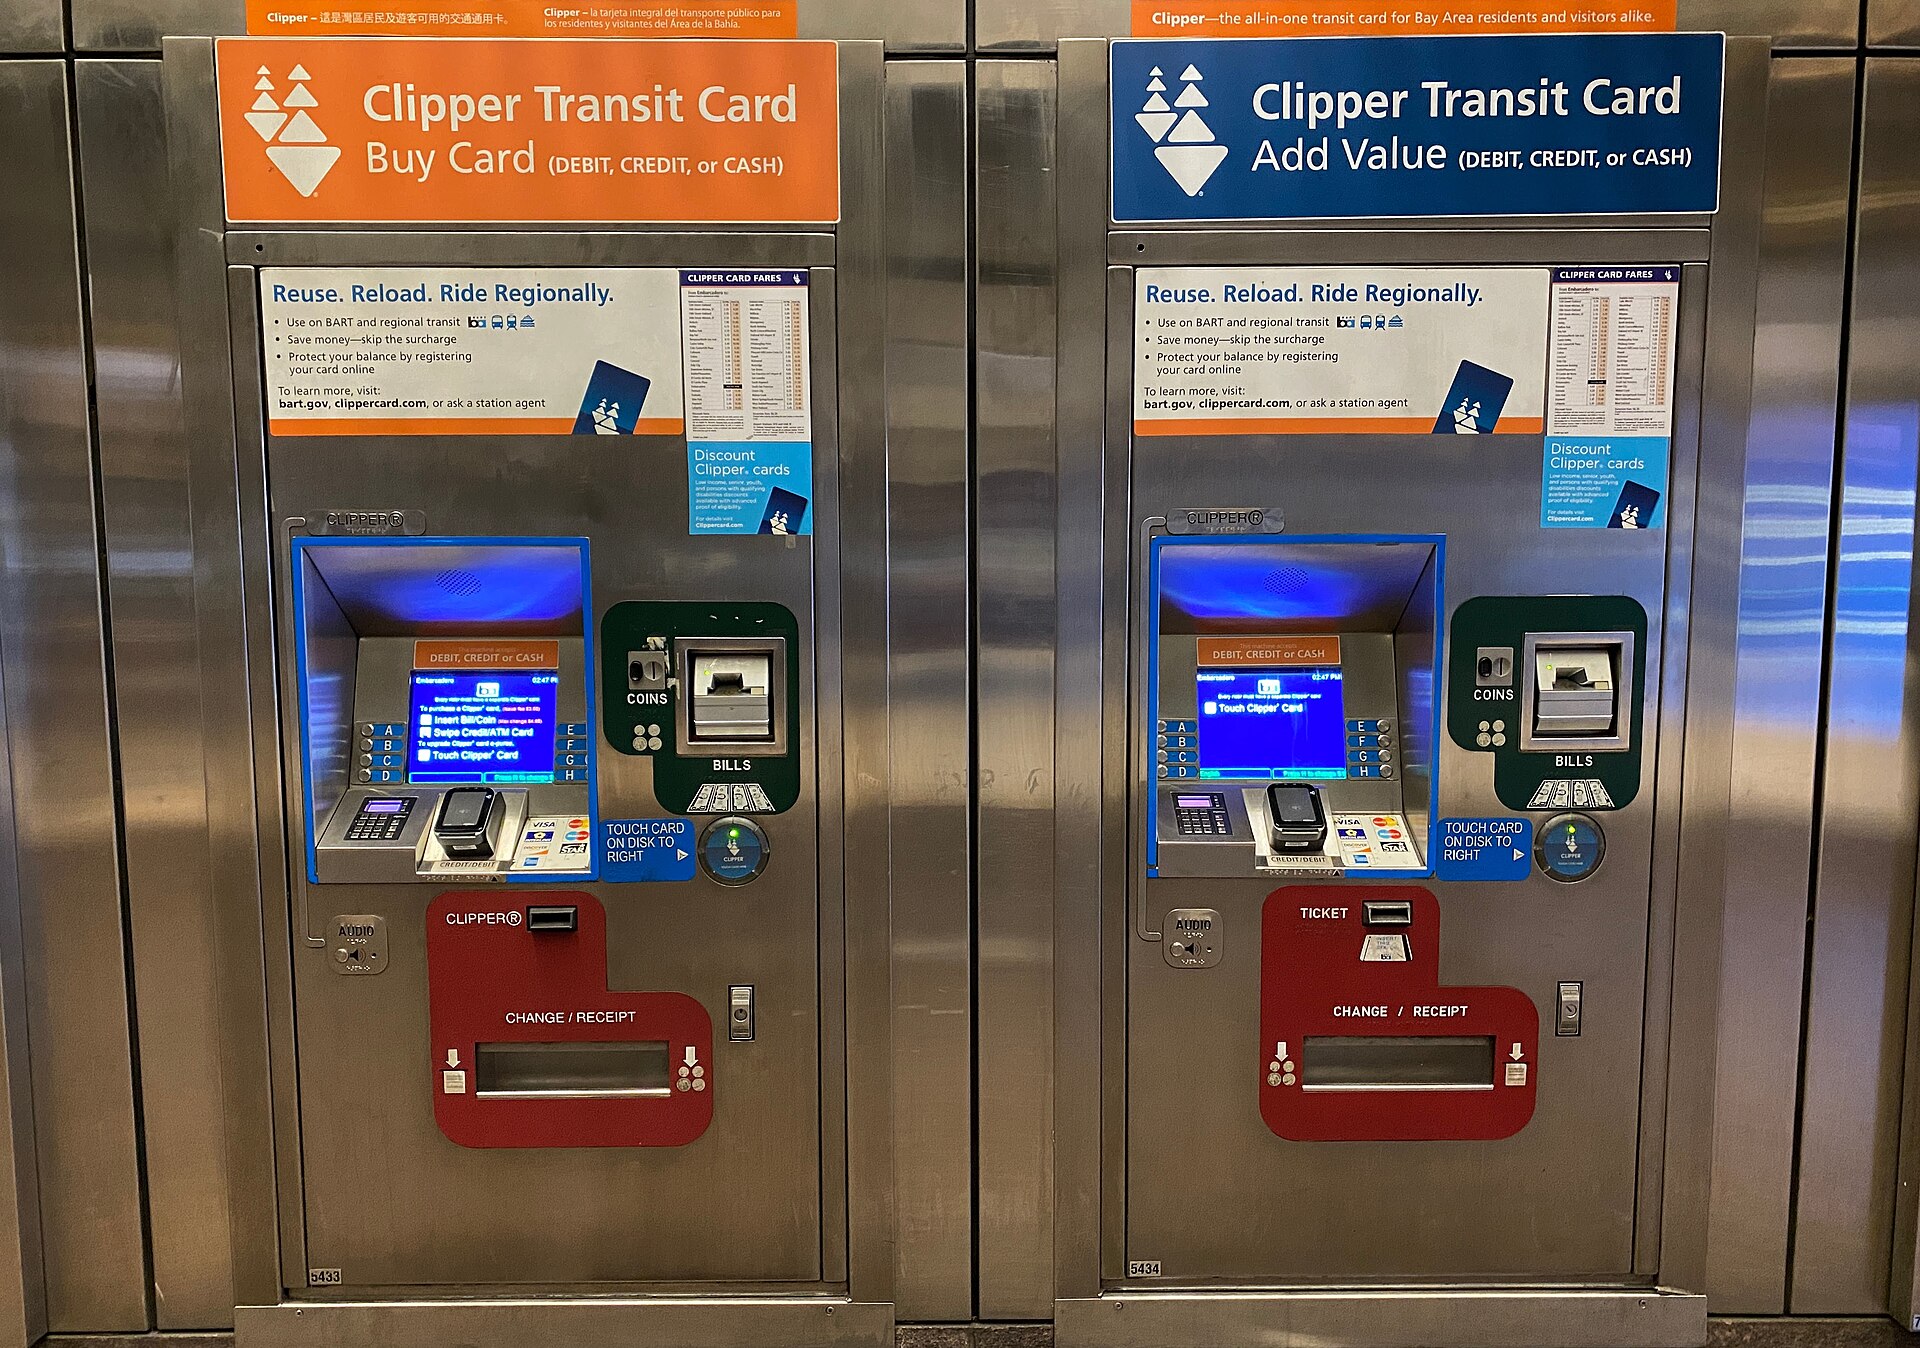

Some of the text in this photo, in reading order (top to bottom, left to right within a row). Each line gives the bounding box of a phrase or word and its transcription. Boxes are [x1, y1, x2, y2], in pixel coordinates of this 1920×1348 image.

[267, 12, 312, 24] Clipper
[544, 8, 781, 19] Clipper la tarjeta integral del transporte público para
[1152, 9, 1654, 27] Clipper—the all-in-one transit card for Bay Area residents and visitors alike.
[544, 18, 740, 30] los residentes y visitantes del Área de la Bahía.
[363, 83, 796, 131] Clipper Transit Card
[1252, 76, 1680, 128] Clipper Transit Card
[1251, 136, 1446, 170] Add Value
[1458, 147, 1691, 170] (DEBIT, CREDIT, or CASH)
[367, 140, 534, 182] Buy Card
[548, 156, 783, 175] (DEBIT, CREDIT, or CASH)
[687, 274, 781, 283] CLIPPER CARD FARES
[1559, 270, 1652, 279] CLIPPER CARD FARES
[273, 282, 613, 306] Reuse. Reload. Ride Regionally.
[1146, 283, 1482, 306] Reuse. Reload. Ride Regionally.
[1158, 318, 1176, 327] Use
[1196, 317, 1224, 327] BART
[1226, 317, 1246, 327] and
[1249, 316, 1292, 329] regional
[1296, 316, 1329, 326] transit
[287, 334, 456, 346] Save money—skip the surcharge
[288, 351, 471, 363] Protect your balance by registering
[289, 364, 374, 376] your card online
[277, 385, 380, 396] To learn more, visit:
[279, 399, 330, 410] bart.gov,
[334, 398, 428, 410] clippercard.com,
[446, 397, 463, 407] ask
[475, 398, 511, 407] station
[515, 399, 545, 409] agent
[1551, 442, 1611, 454] Discount
[694, 449, 755, 461] Discount
[1607, 457, 1644, 469] cards
[752, 464, 790, 475] cards
[430, 653, 460, 662] DEBIT,
[463, 653, 499, 662] CREDIT
[516, 653, 543, 662] CASH
[1212, 650, 1242, 659] DEBIT,
[1245, 650, 1281, 658] CREDIT
[1297, 649, 1324, 658] CASH
[627, 693, 667, 704] COINS
[1473, 688, 1513, 700] COINS
[1219, 704, 1245, 712] Touch
[1282, 704, 1303, 712] Card
[435, 716, 459, 724] Insert
[1358, 721, 1365, 731] E
[384, 725, 392, 736] A
[384, 740, 392, 750] B
[1359, 736, 1365, 746] F
[383, 755, 391, 766] C
[1359, 751, 1367, 761] G
[1555, 755, 1592, 766] BILLS
[712, 759, 750, 770] BILLS
[382, 770, 390, 780] D
[1360, 766, 1368, 776] H
[606, 822, 684, 835] TOUCH CARD
[1445, 822, 1522, 833] TOUCH CARD
[606, 835, 674, 849] ON DISK TO
[1444, 835, 1511, 847] ON DISK TO
[607, 850, 643, 862] RIGHT
[1270, 856, 1326, 864] CREDIT/DEBIT
[1444, 849, 1480, 860] RIGHT
[440, 861, 496, 869] CREDIT/DEBIT
[1300, 907, 1348, 918] TICKET
[1176, 919, 1212, 931] AUDIO
[338, 925, 375, 938] AUDIO
[505, 1012, 564, 1023] CHANGE
[576, 1011, 636, 1022] RECEIPT
[1333, 1005, 1388, 1017] CHANGE
[1413, 1005, 1468, 1016] RECEIPT
[1130, 1263, 1159, 1274] 5434
[310, 1270, 340, 1282] 5433
